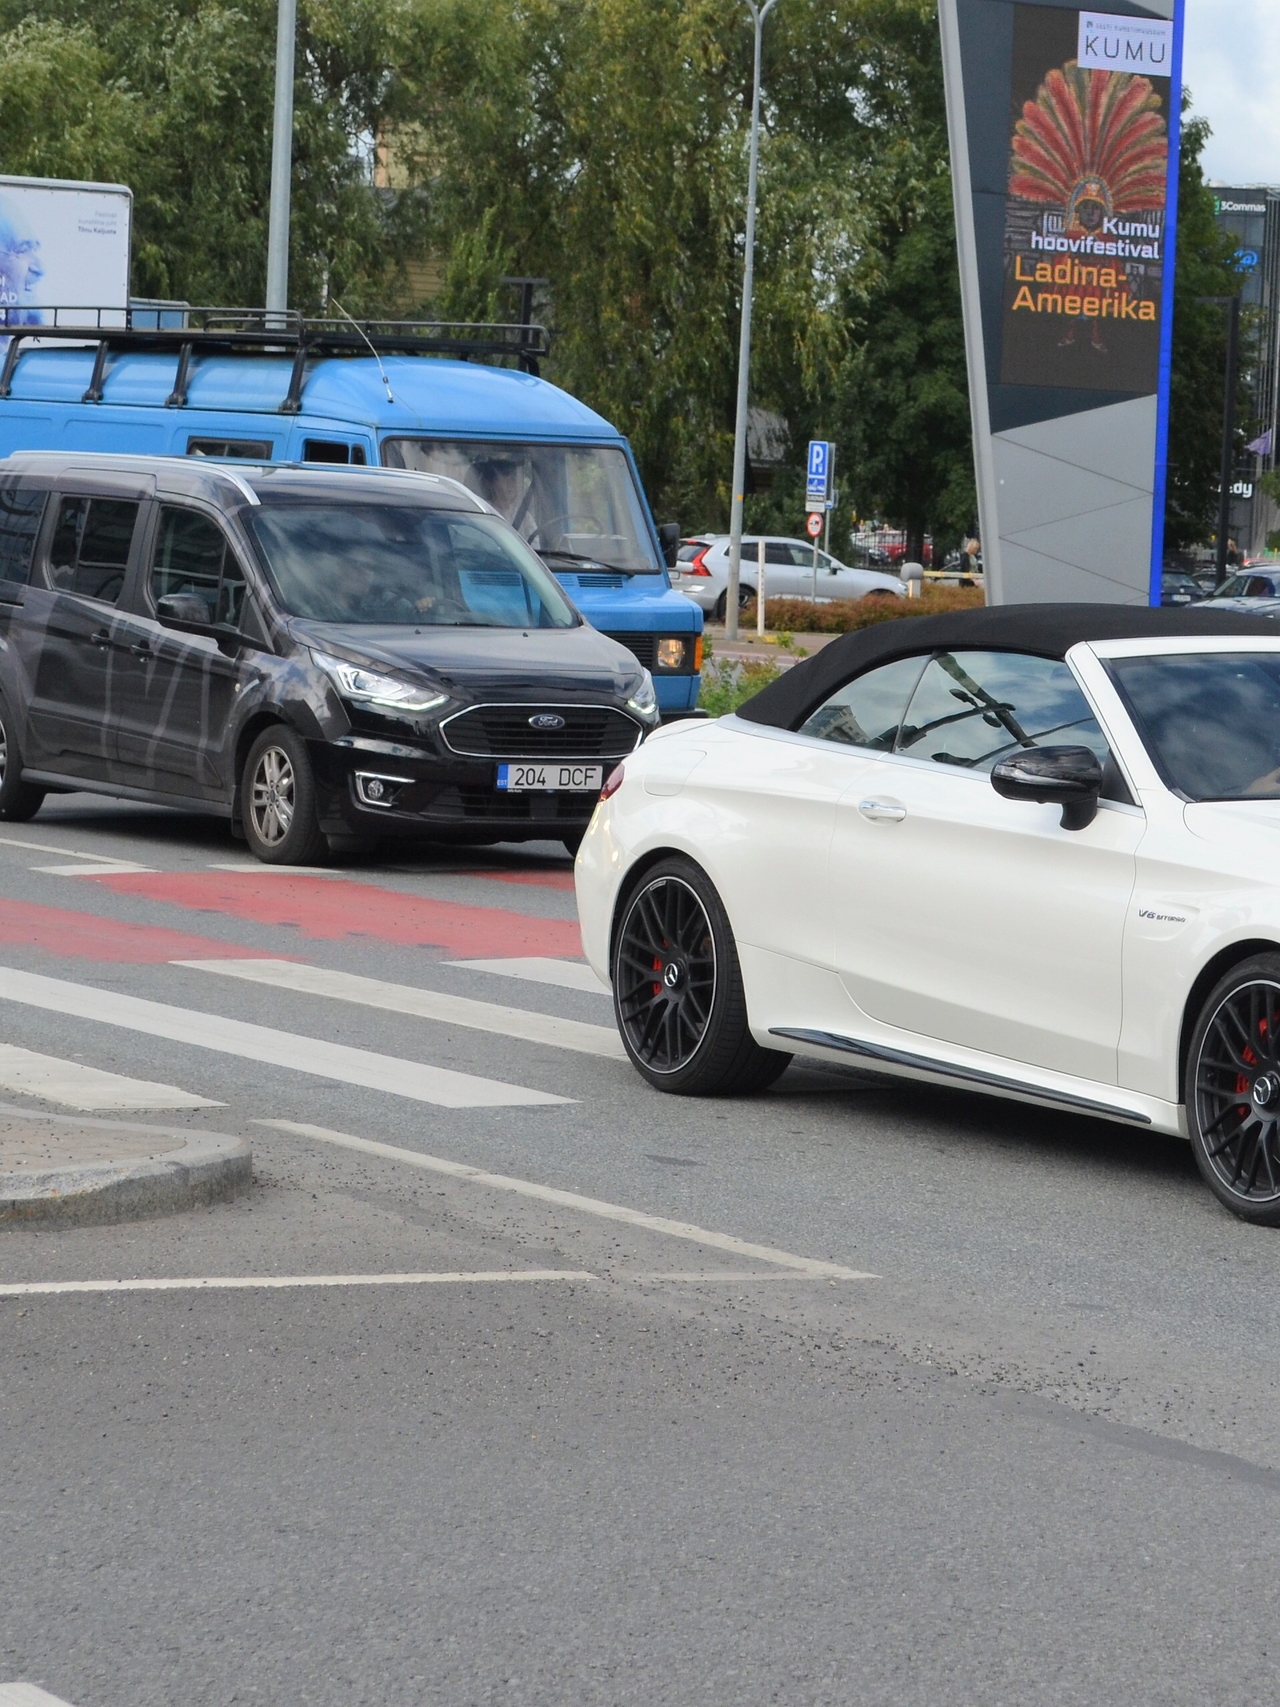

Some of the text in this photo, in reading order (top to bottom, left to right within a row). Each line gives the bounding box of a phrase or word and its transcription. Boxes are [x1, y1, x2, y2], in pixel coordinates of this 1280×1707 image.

[1086, 35, 1165, 63] KUMU
[1221, 201, 1266, 212] 3Commas
[1103, 217, 1160, 238] Kumu
[1031, 231, 1160, 259] hoovifestival
[1015, 255, 1127, 288] Ladina-
[1012, 285, 1156, 321] Ameerika
[811, 444, 824, 473] P
[537, 716, 559, 727] Ford
[514, 768, 596, 786] 204 DCF
